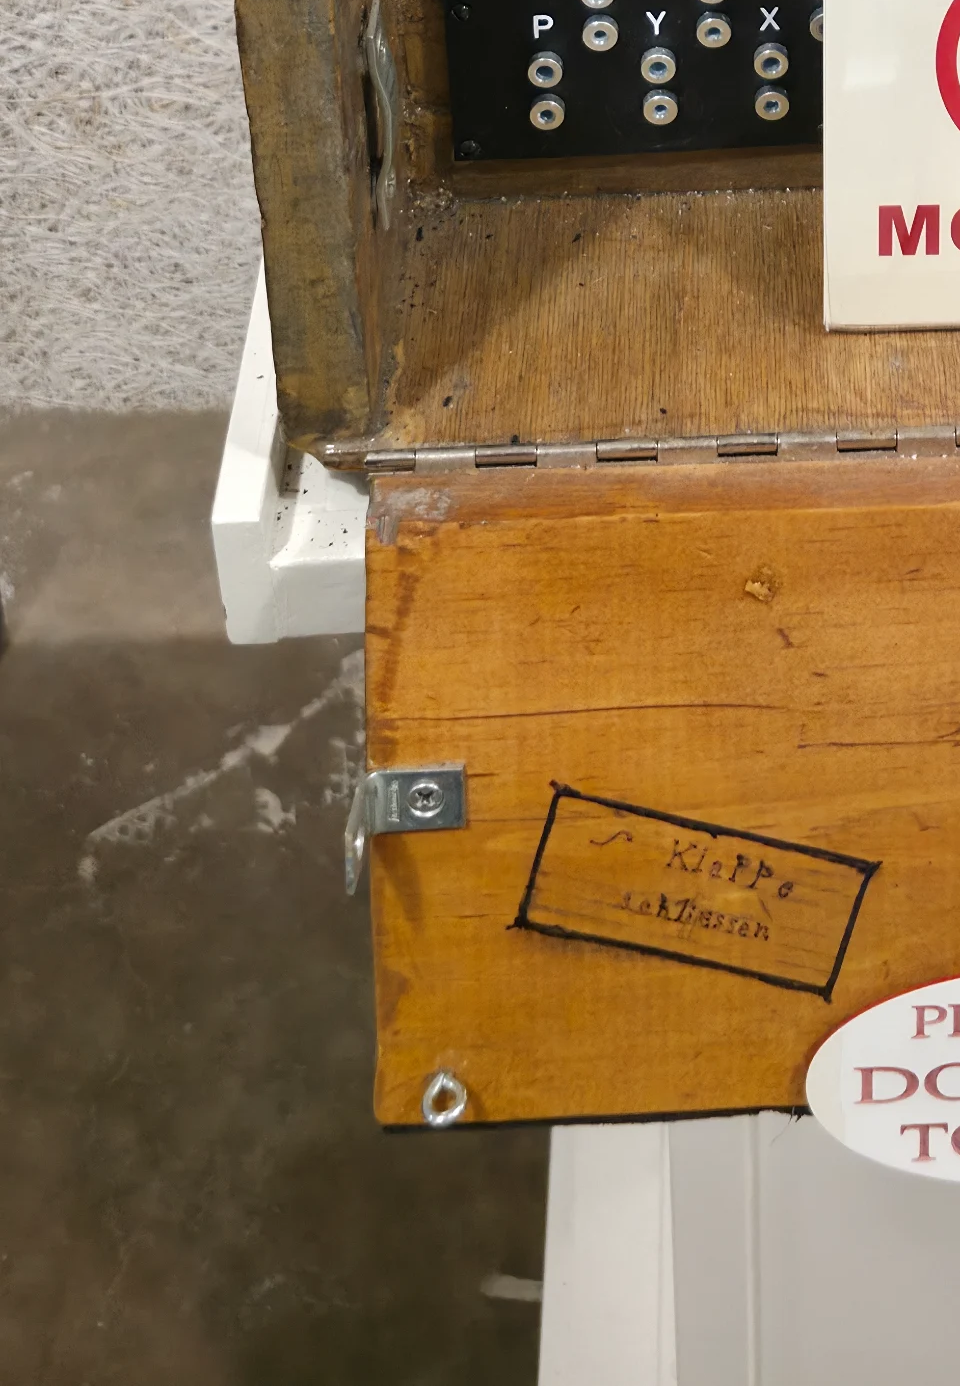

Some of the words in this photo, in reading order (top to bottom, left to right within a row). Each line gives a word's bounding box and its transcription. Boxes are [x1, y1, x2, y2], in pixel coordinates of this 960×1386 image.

[532, 15, 554, 39] P
[645, 11, 667, 35] Y
[759, 7, 780, 31] X
